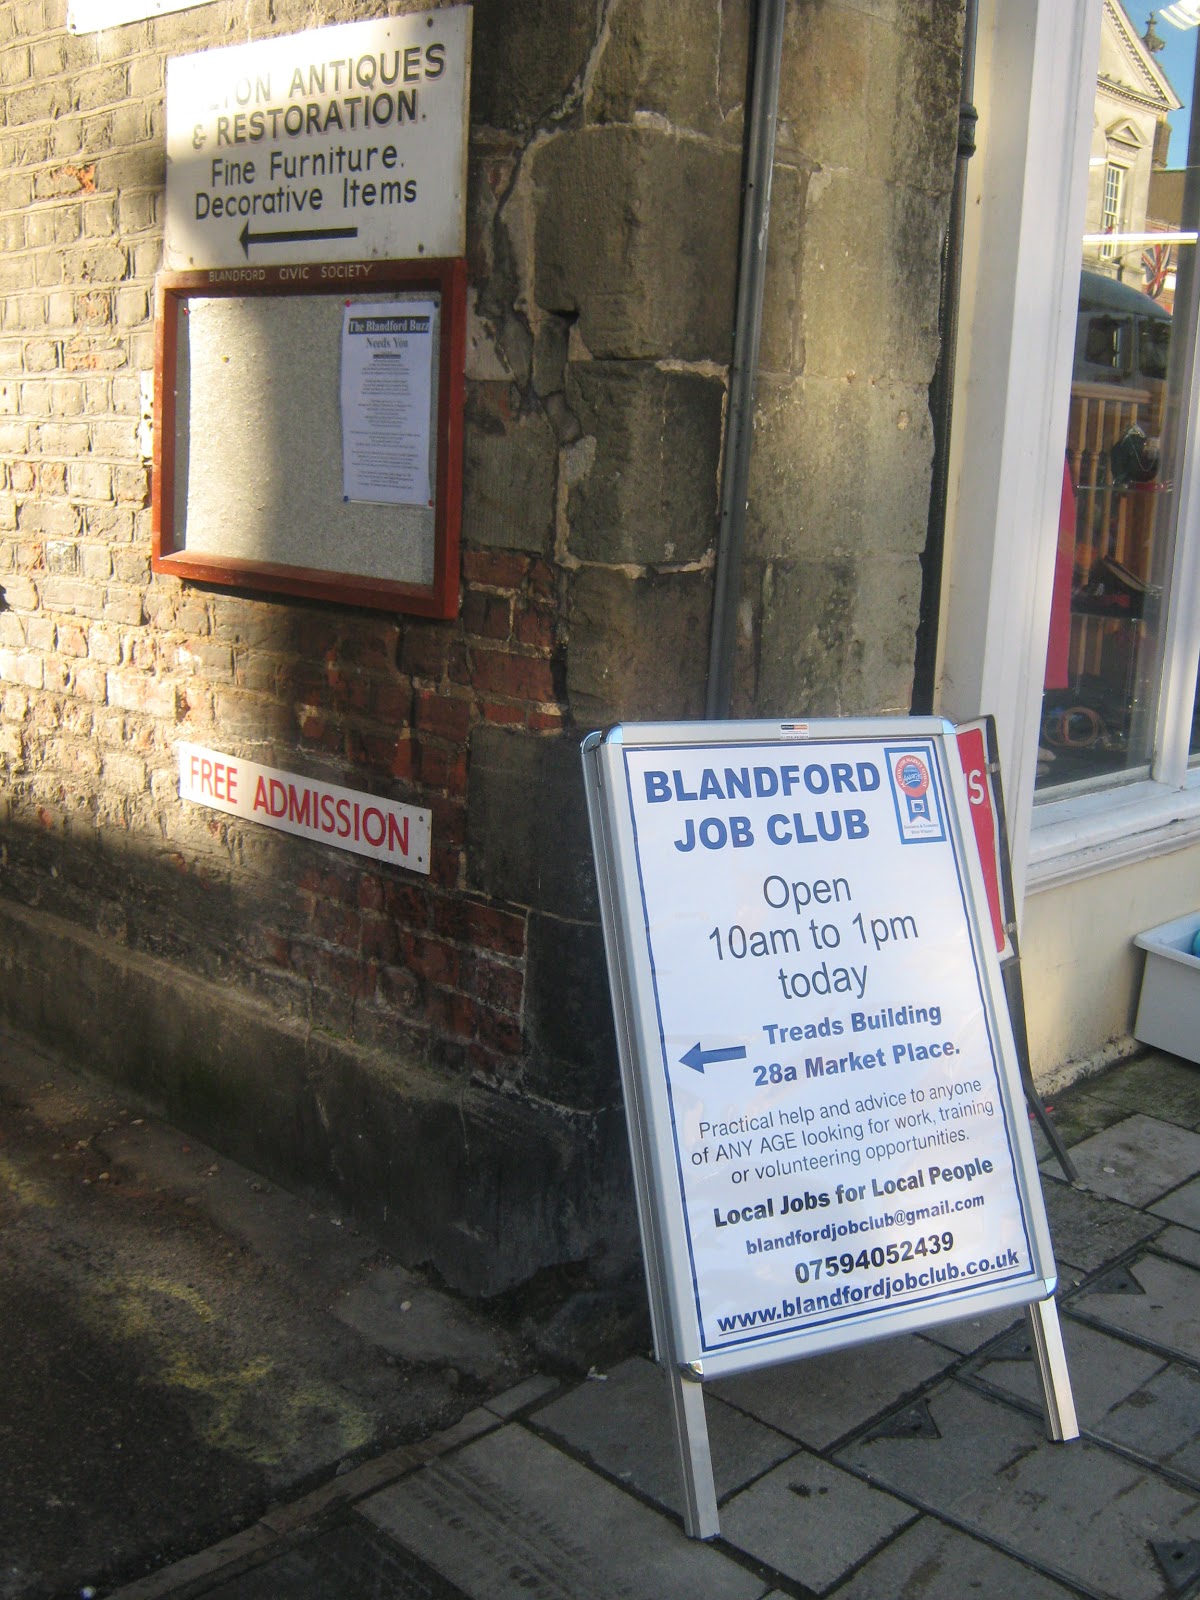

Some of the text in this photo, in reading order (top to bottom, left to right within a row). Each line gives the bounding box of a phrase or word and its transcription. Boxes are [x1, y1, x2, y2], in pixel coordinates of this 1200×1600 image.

[288, 43, 447, 99] ANTIQUES
[191, 88, 427, 150] & RESTORATION.
[211, 144, 405, 188] Fine Furniture.
[195, 177, 418, 221] Decorative Items
[208, 264, 373, 283] BLANDFORD CIVIC SOCIETY
[350, 319, 429, 333] The Blandford Buzz
[366, 337, 408, 348] Needs You
[190, 755, 409, 856] FREE ADMISSION
[643, 761, 881, 804] BLANDFORD
[673, 808, 870, 853] JOB CLUB
[763, 875, 852, 914] Open
[708, 912, 919, 961] 10am to 1pm
[778, 962, 868, 1000] today
[762, 1004, 942, 1046] Treads Building
[752, 1039, 960, 1087] 28a Market Place.
[691, 1099, 994, 1166] of ANY AGE looking for work, training
[699, 1079, 982, 1139] Practical help and advice to anyone
[731, 1129, 970, 1184] or volunteering opportunities.
[713, 1157, 994, 1228] Local Jobs for Local People
[746, 1194, 986, 1256] blandfordjobclub@gmail.com
[794, 1231, 955, 1284] 07594052439
[716, 1248, 1020, 1333] www.blandfordjobclub.co.uk
